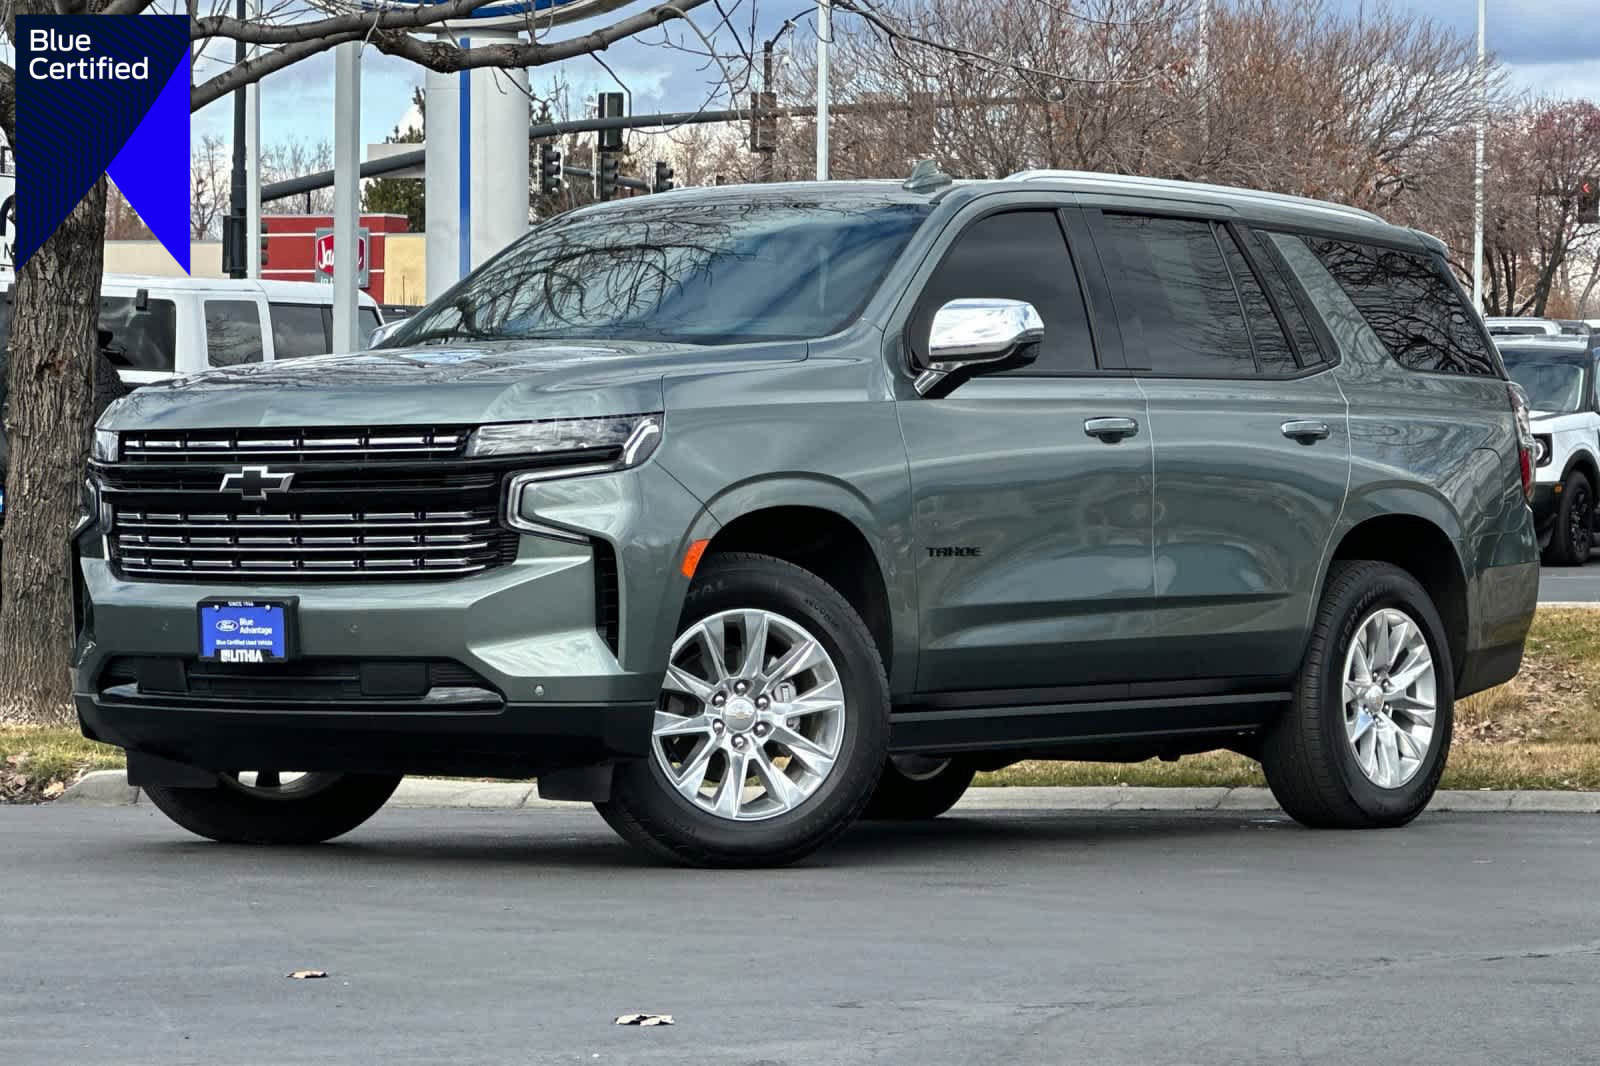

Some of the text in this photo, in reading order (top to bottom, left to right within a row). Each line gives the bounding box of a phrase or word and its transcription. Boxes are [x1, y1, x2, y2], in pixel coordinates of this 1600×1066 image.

[925, 546, 982, 557] TAHOE
[239, 617, 254, 626] Blue
[239, 626, 272, 636] Advantage
